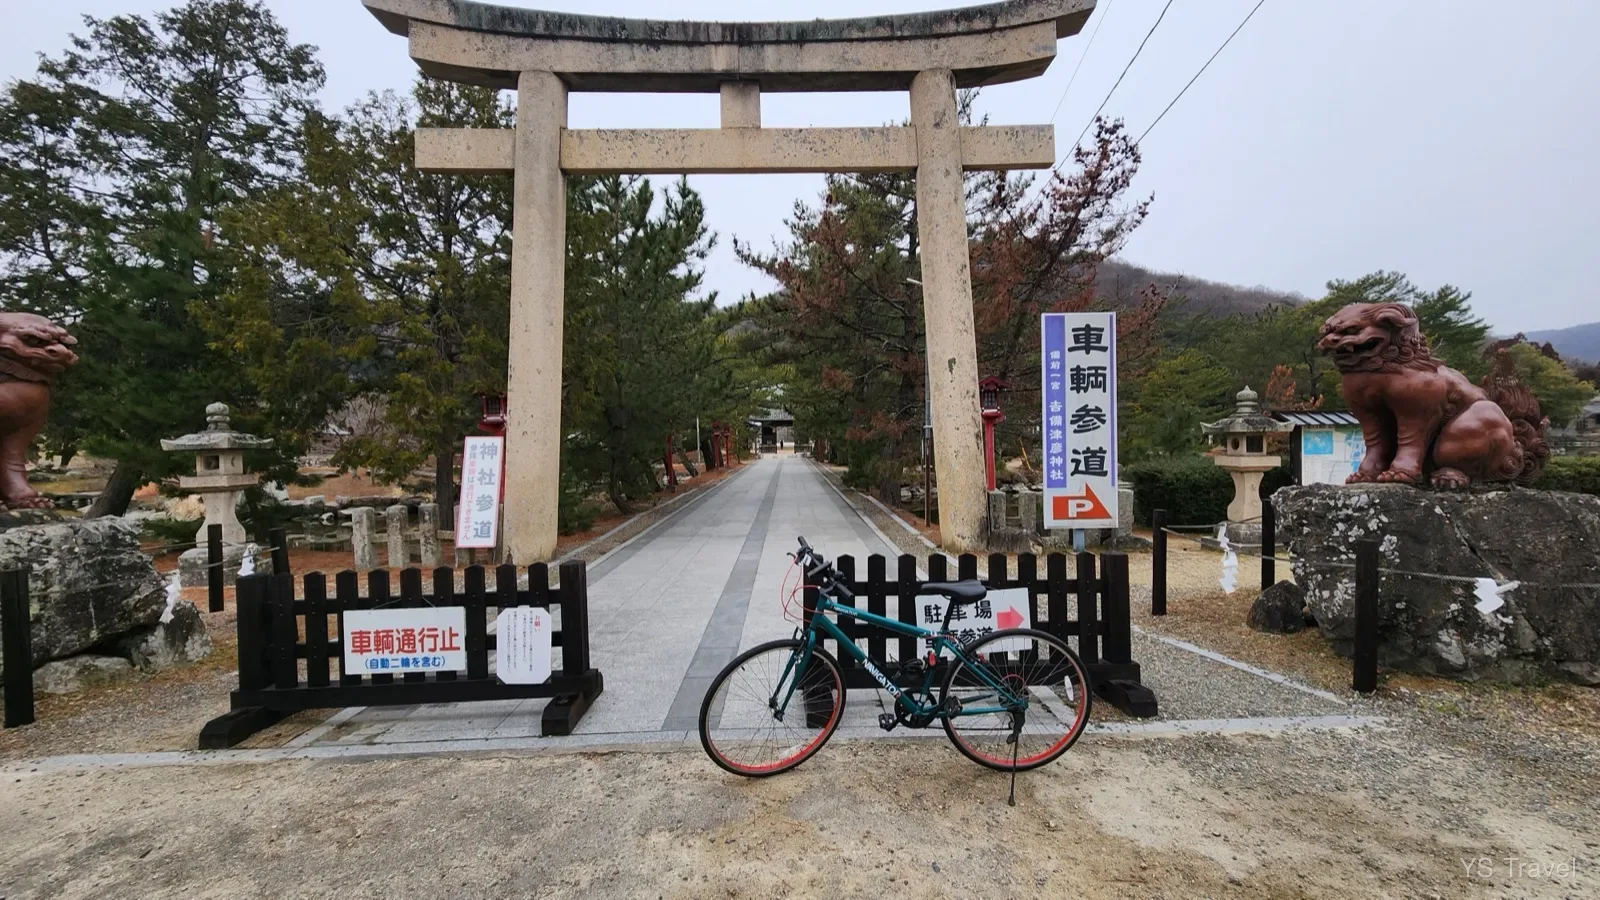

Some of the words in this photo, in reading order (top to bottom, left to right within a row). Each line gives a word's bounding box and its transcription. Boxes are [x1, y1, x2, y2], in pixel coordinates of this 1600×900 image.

[1067, 323, 1109, 478] 車輌参道
[1049, 400, 1064, 481] 吉備津彦神社
[472, 442, 498, 539] 神社参道
[1067, 499, 1094, 518] P
[350, 626, 461, 656] 車輌通行止
[862, 658, 902, 700] NAVIGATOR
